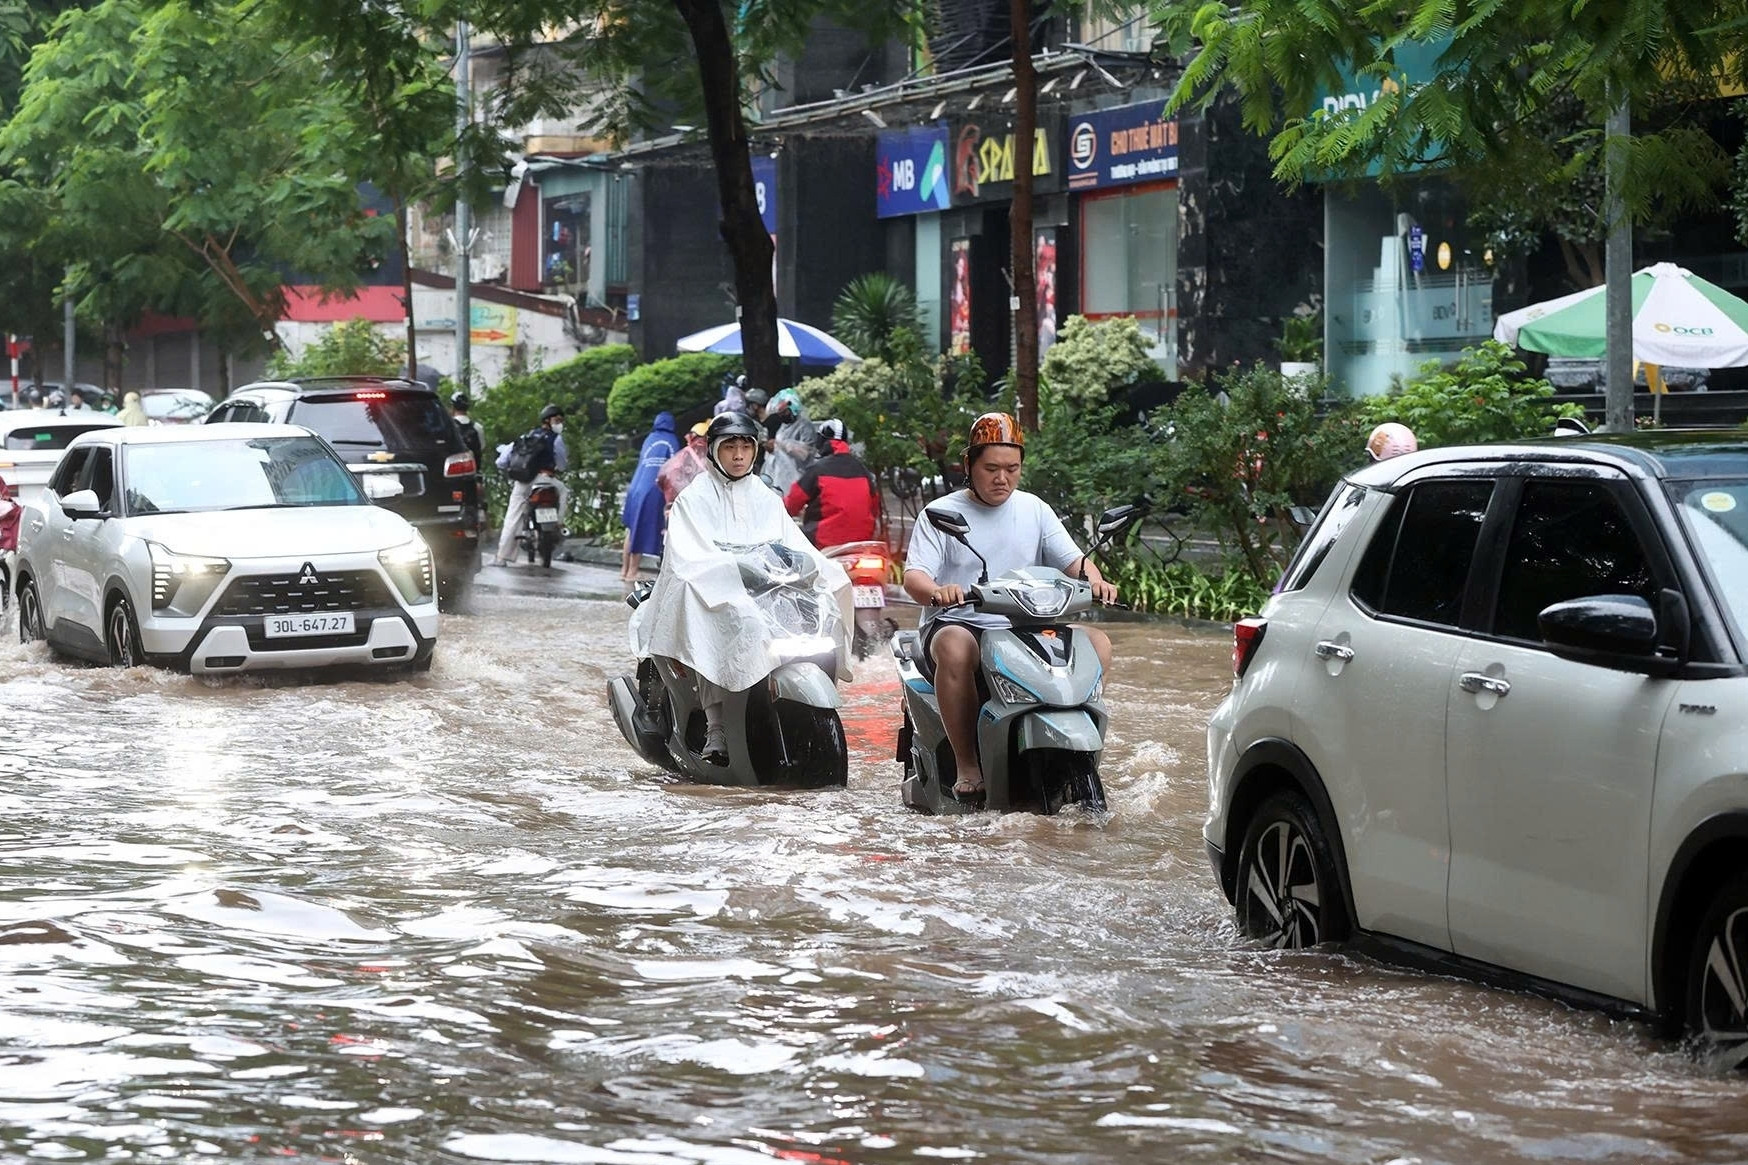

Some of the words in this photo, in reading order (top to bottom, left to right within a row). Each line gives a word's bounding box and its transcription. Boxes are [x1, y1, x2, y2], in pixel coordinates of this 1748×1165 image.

[977, 127, 1052, 185] SPAA
[893, 158, 915, 192] MB
[755, 181, 767, 215] B
[1673, 325, 1714, 337] OCB
[272, 616, 347, 634] 30L-647.27
